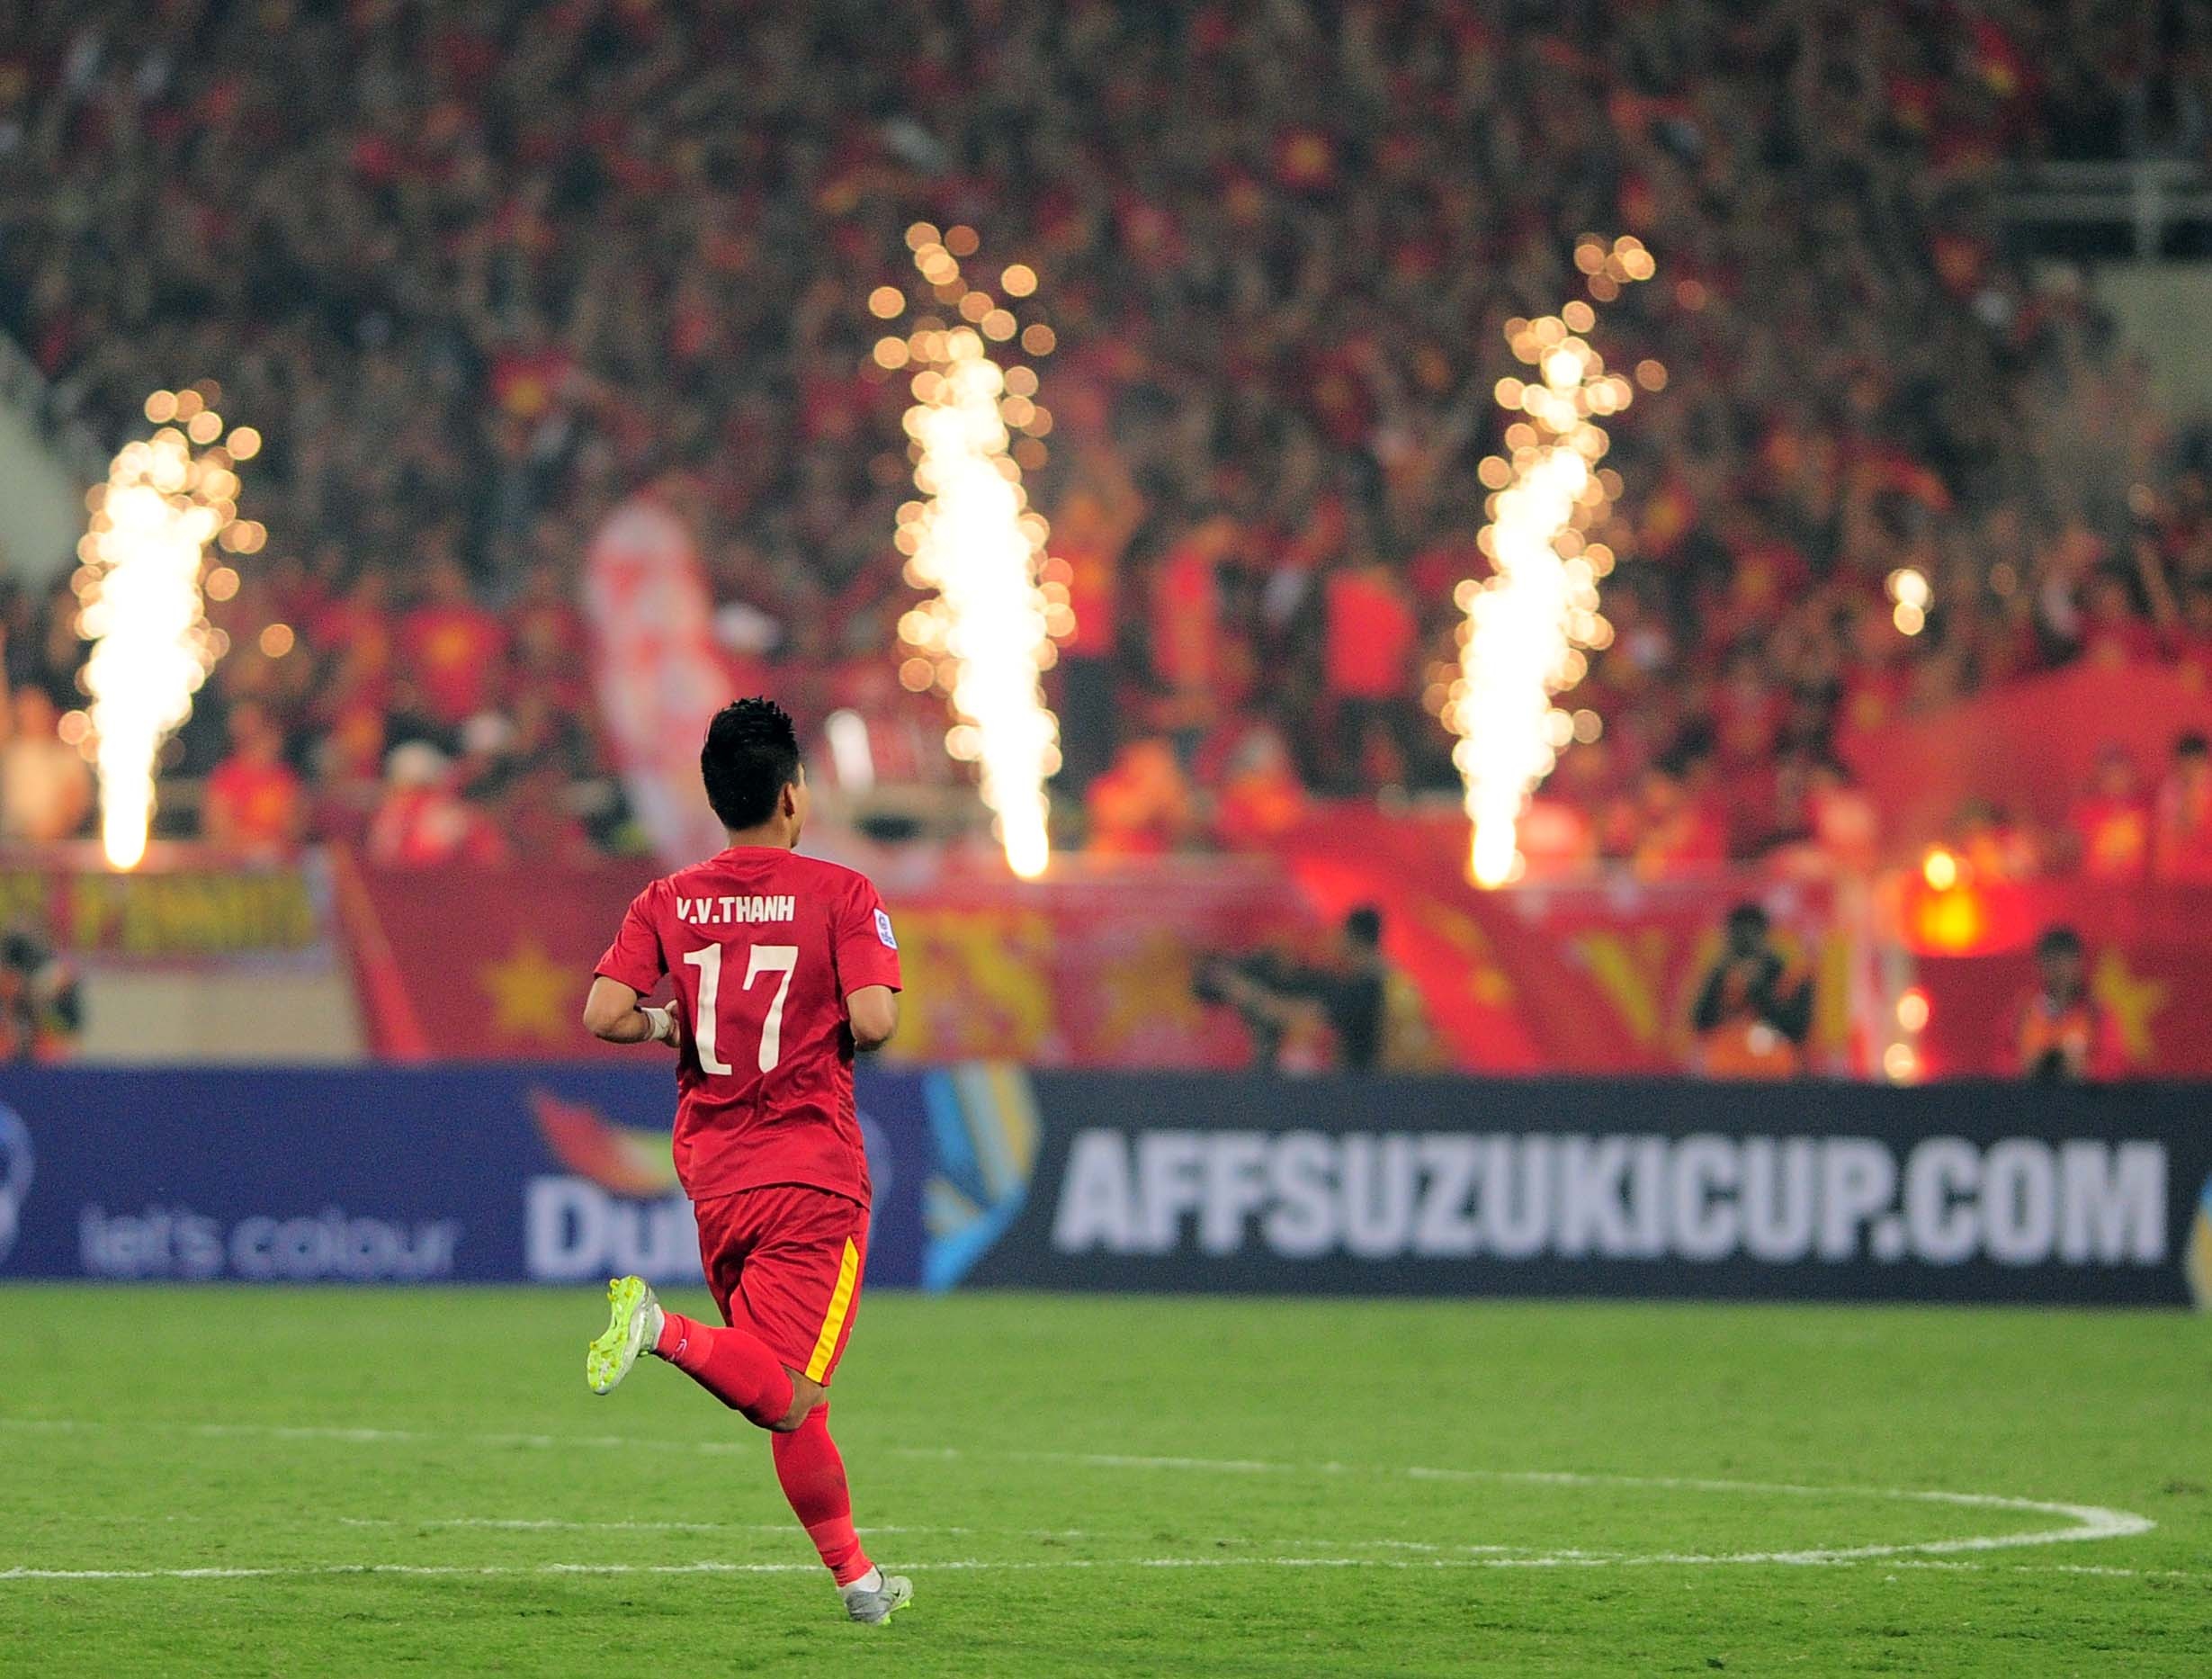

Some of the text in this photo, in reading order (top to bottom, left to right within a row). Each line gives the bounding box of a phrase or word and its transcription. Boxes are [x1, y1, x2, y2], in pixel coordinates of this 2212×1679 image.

[676, 895, 796, 924] V.V.THANH
[684, 942, 799, 1076] 17
[1054, 1128, 2168, 1263] AFFSUZUKICUP.COM
